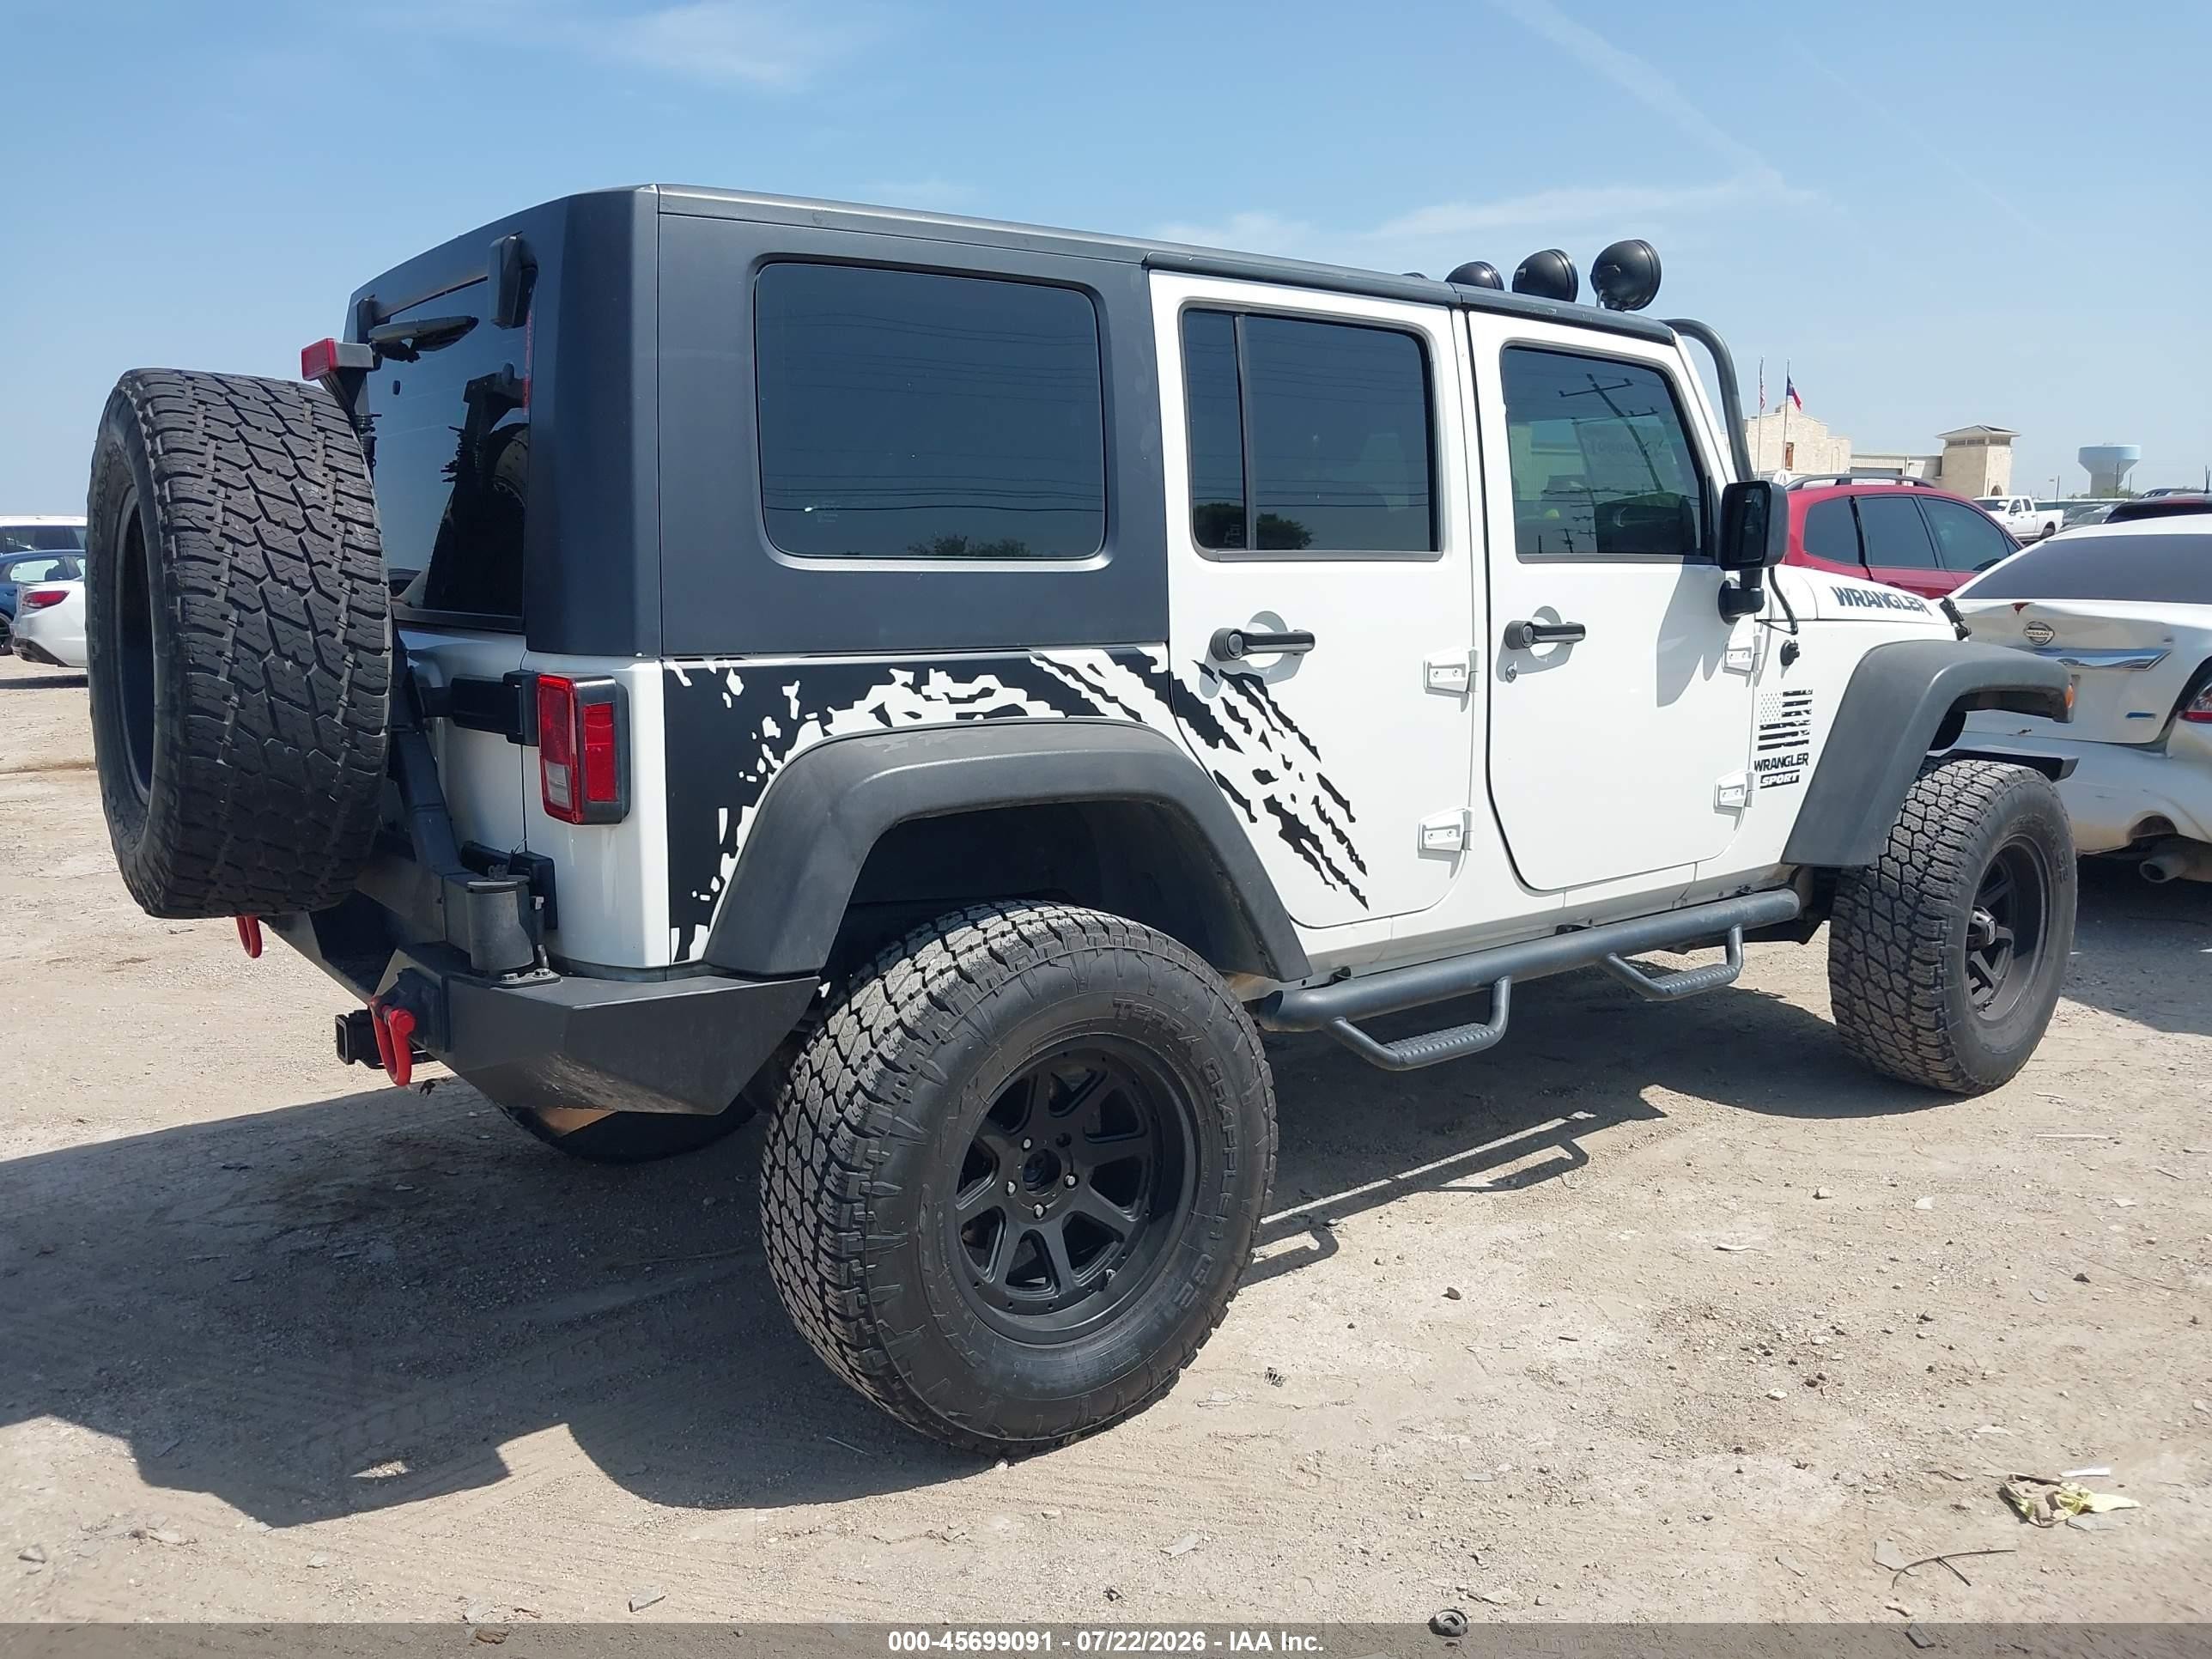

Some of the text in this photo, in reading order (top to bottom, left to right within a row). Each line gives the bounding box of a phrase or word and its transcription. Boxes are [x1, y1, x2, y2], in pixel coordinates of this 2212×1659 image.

[1830, 586, 1933, 616] WRANGLER
[1753, 753, 1808, 772] WRANGLER
[1761, 774, 1799, 787] SPORT
